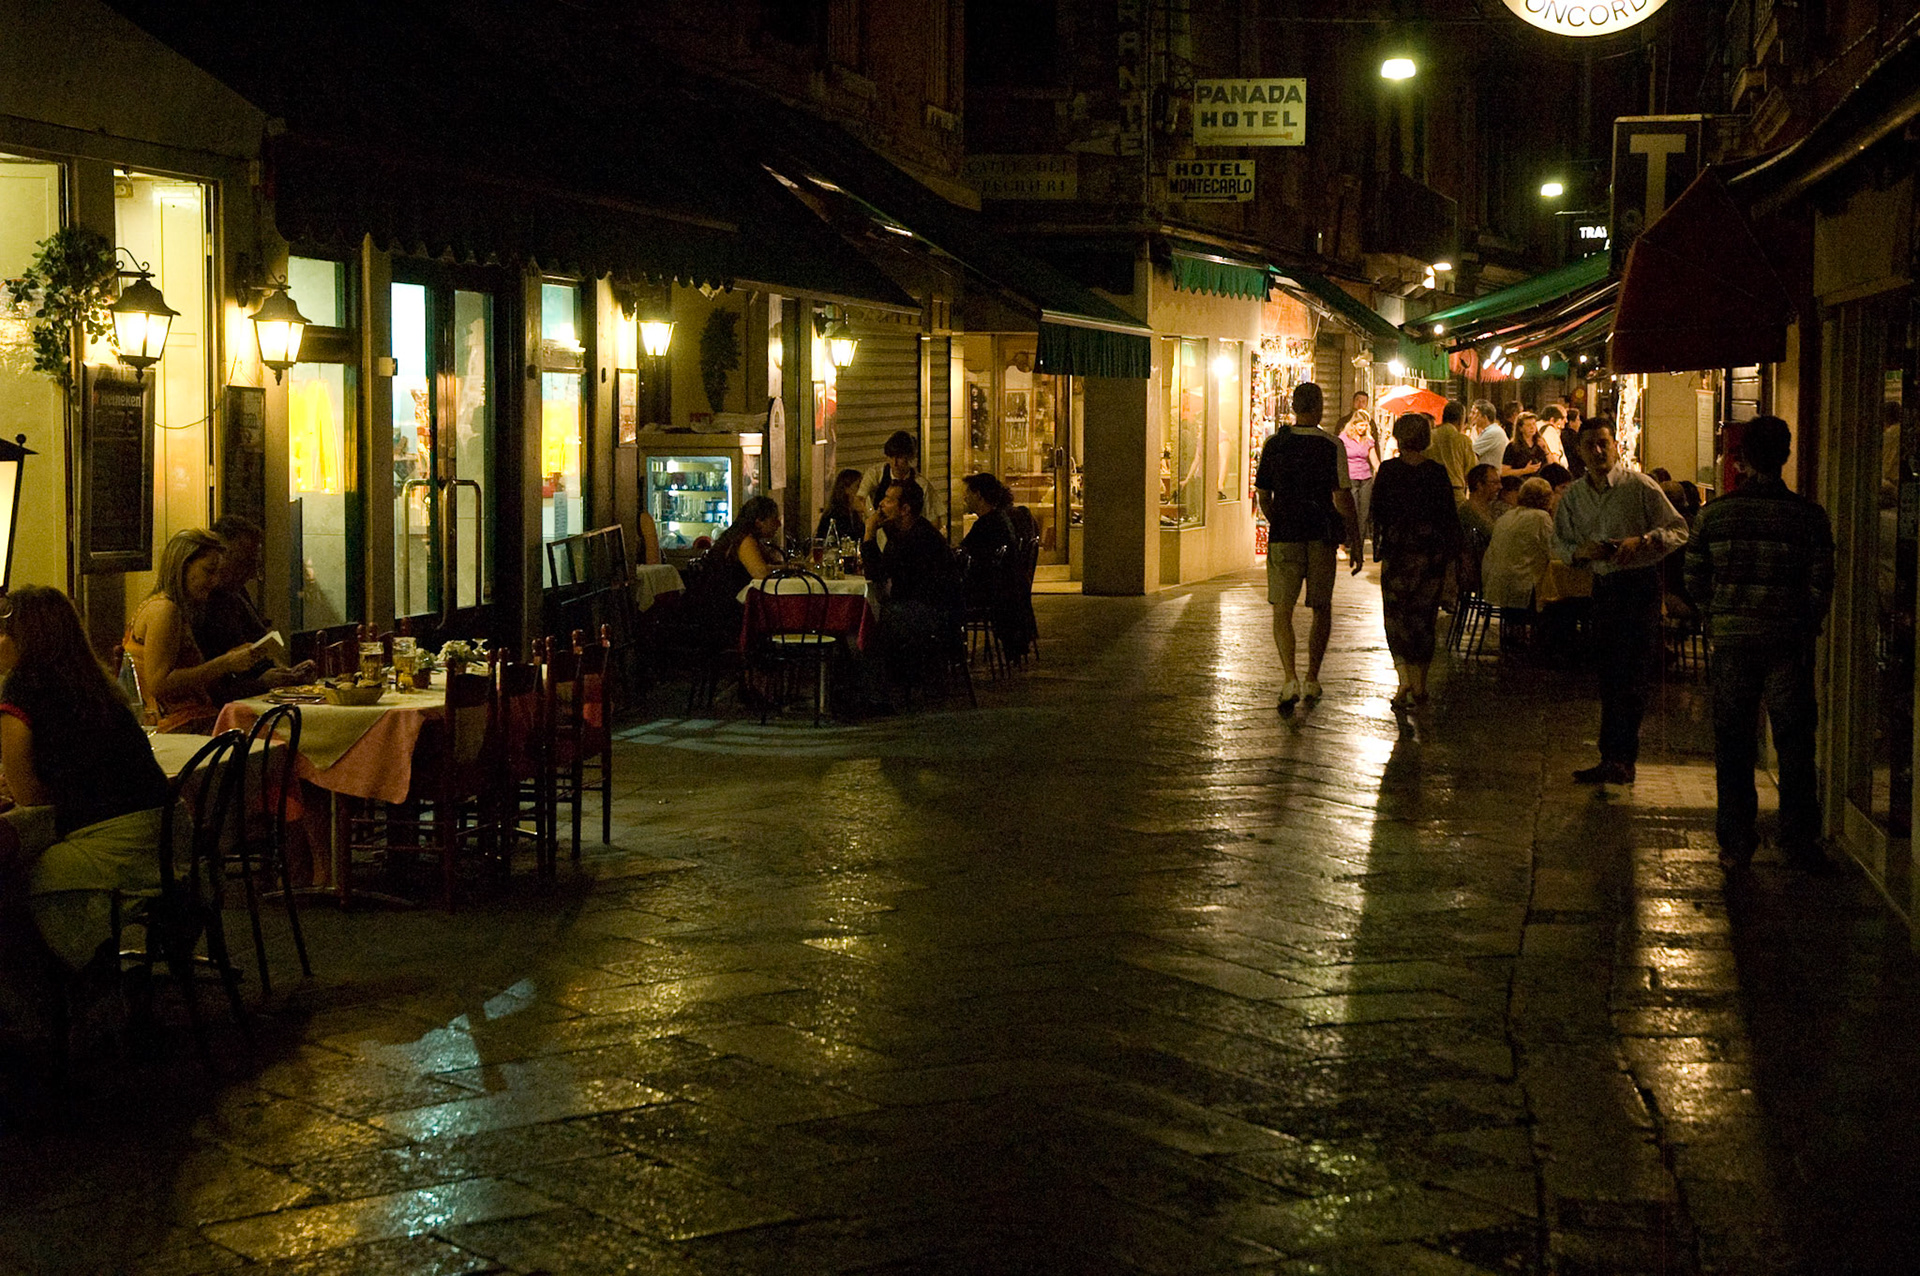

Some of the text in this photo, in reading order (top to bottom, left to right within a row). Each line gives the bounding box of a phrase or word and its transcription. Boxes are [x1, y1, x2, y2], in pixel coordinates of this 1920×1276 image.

[1195, 85, 1303, 104] PANADA
[1200, 110, 1298, 128] HOTEL
[1175, 163, 1247, 176] HOTEL
[1169, 178, 1252, 194] MONTECARLO
[1630, 133, 1687, 230] T
